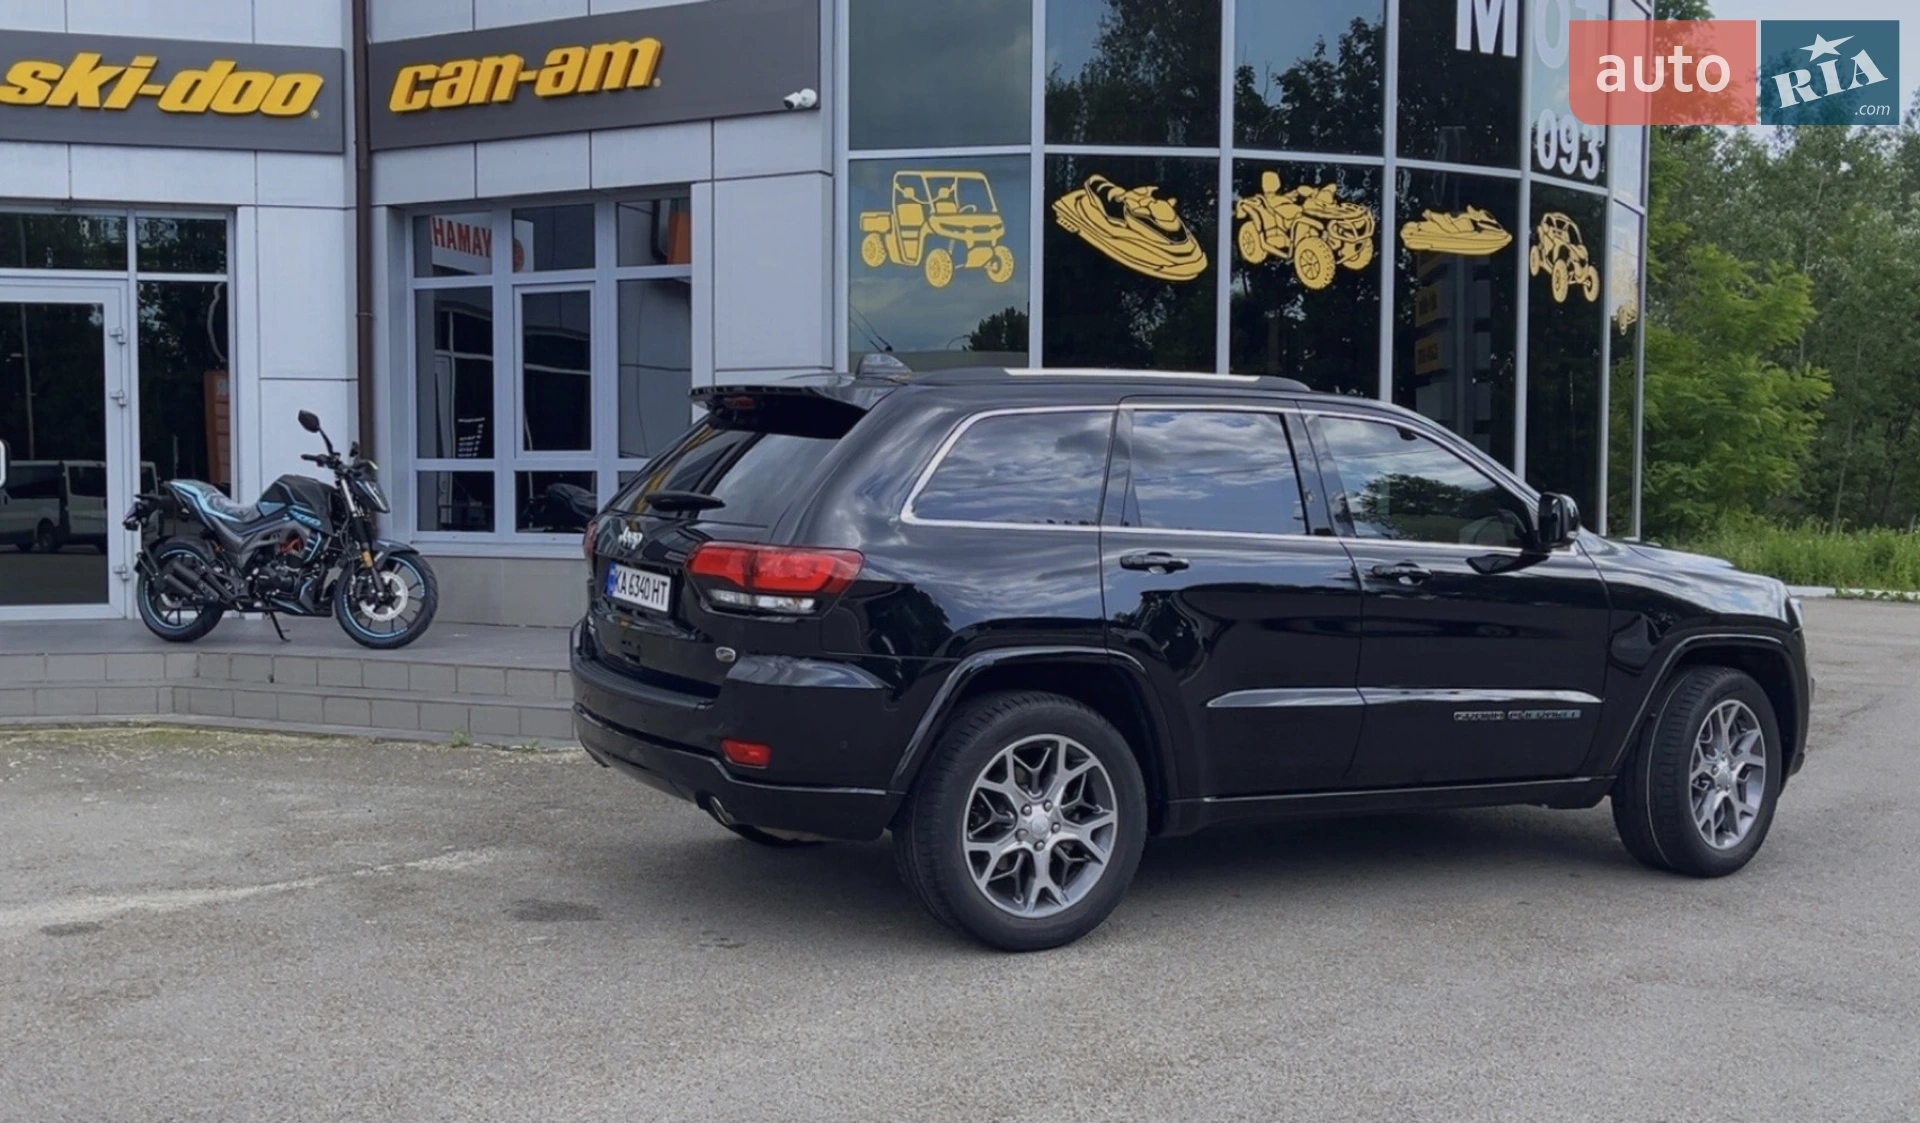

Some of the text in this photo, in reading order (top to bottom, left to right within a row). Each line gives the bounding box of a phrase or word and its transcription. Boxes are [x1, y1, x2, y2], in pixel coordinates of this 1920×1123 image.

[0, 52, 325, 116] ski-doo
[389, 37, 661, 112] can-am
[1537, 108, 1601, 180] 093
[652, 578, 668, 606] HT
